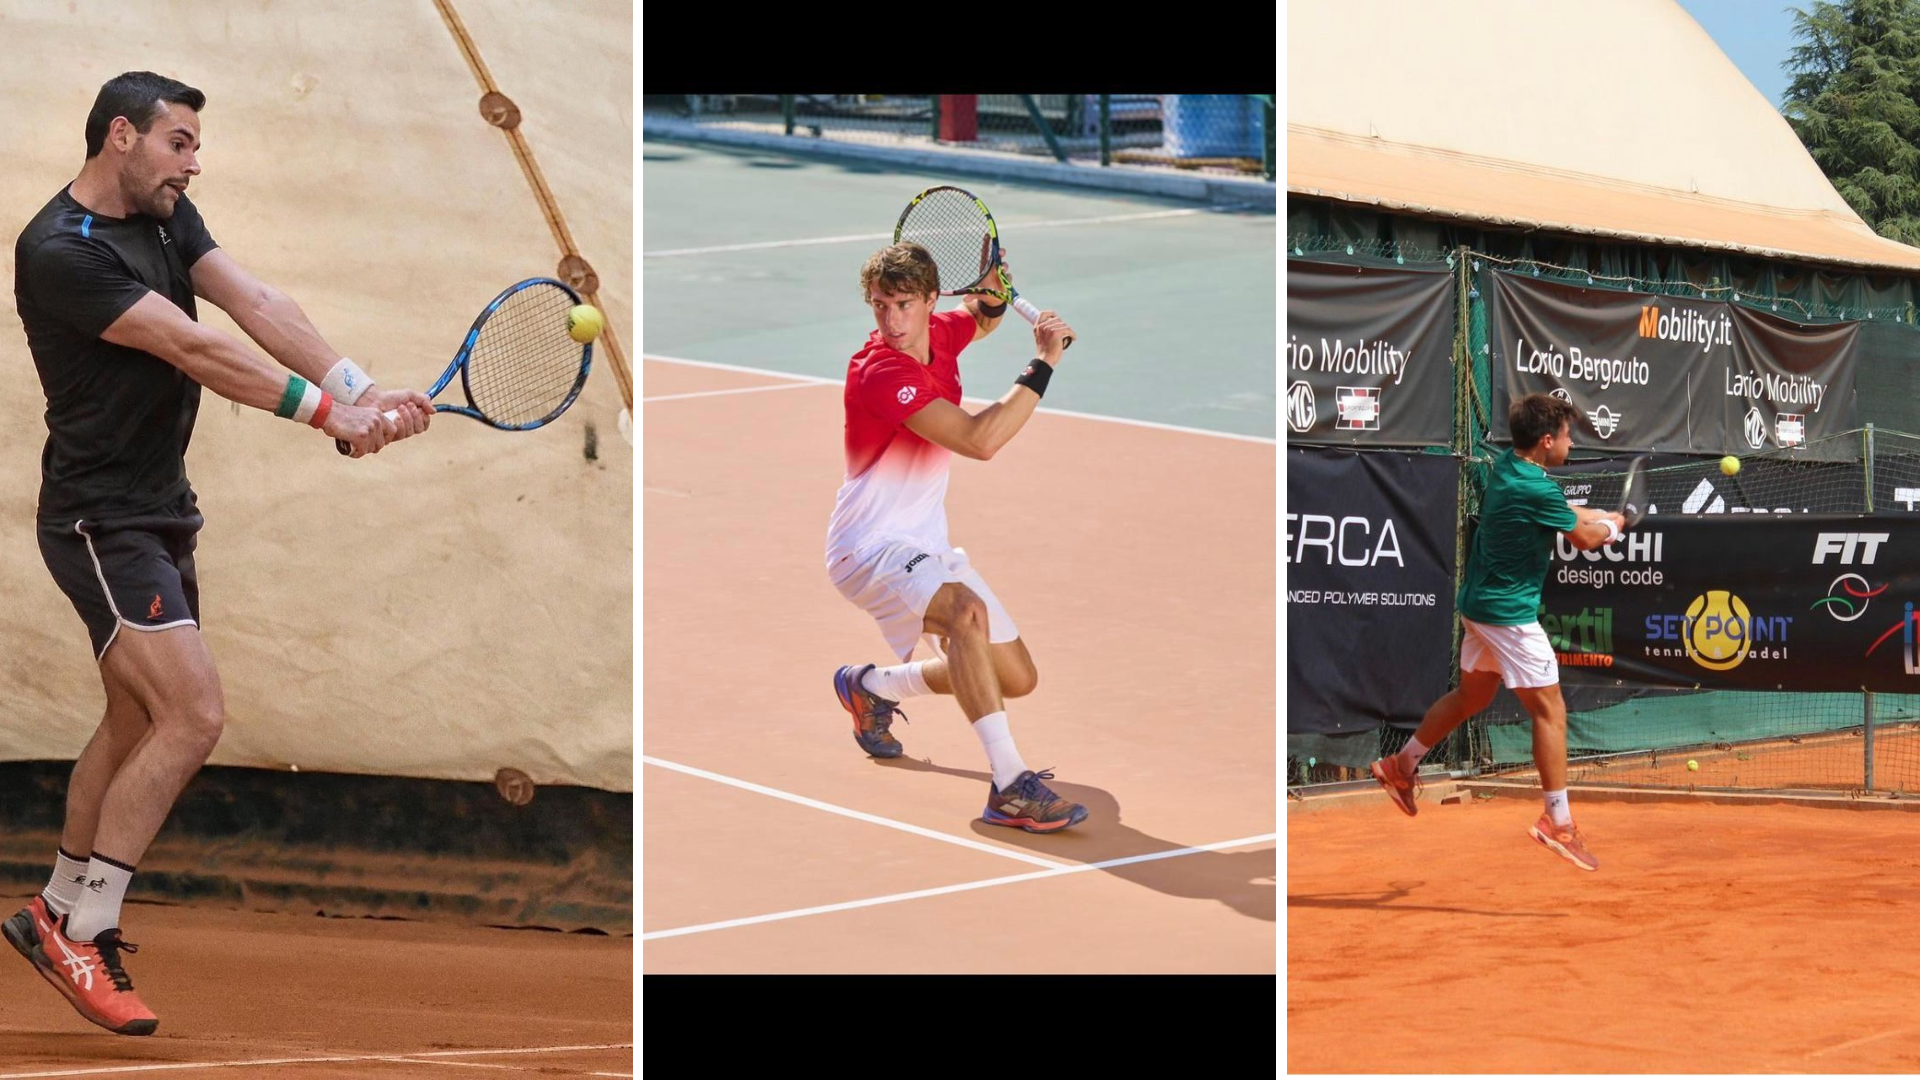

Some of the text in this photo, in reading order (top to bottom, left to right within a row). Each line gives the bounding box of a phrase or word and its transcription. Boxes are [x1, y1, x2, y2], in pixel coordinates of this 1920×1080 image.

[1639, 305, 1732, 353] Mobility.it
[1320, 338, 1411, 385] Mobility
[1569, 346, 1649, 390] Bergauto
[1287, 384, 1314, 429] MG
[1726, 366, 1827, 412] Lario Mobility
[1563, 484, 1592, 496] GRUPPO
[1287, 513, 1404, 567] ERCA
[1812, 532, 1890, 565] FIT
[1557, 565, 1664, 589] design code
[1323, 591, 1379, 605] POLYMER
[1380, 592, 1436, 607] SOLUTIONS
[1645, 611, 1794, 642] SET POINT
[1645, 645, 1699, 658] tennis
[1737, 647, 1788, 662] padel
